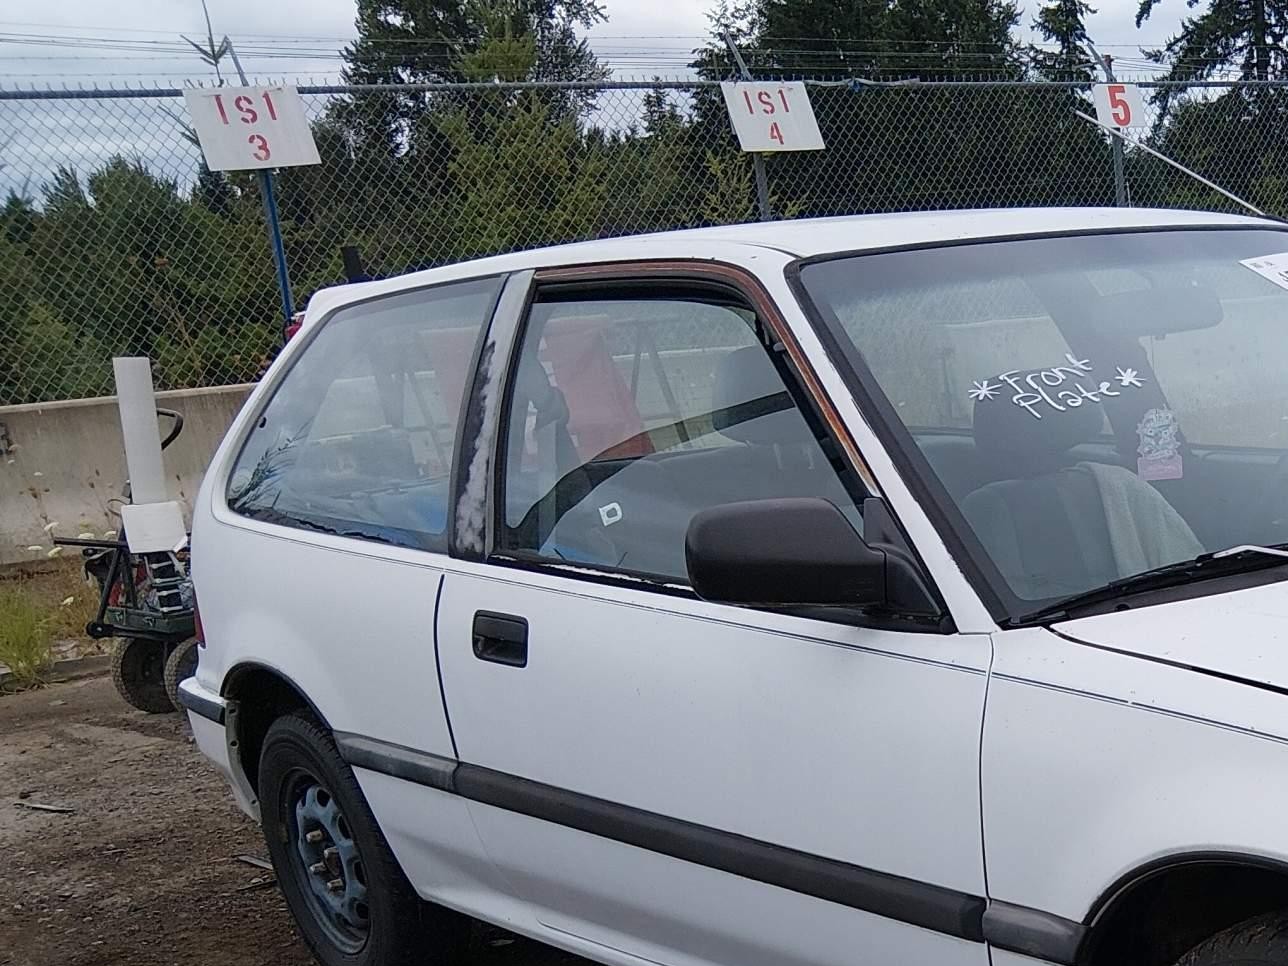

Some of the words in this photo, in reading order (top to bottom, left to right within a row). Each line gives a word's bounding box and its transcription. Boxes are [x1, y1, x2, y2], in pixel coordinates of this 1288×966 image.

[1108, 85, 1131, 126] 5
[770, 122, 784, 145] 4
[249, 134, 271, 161] 3
